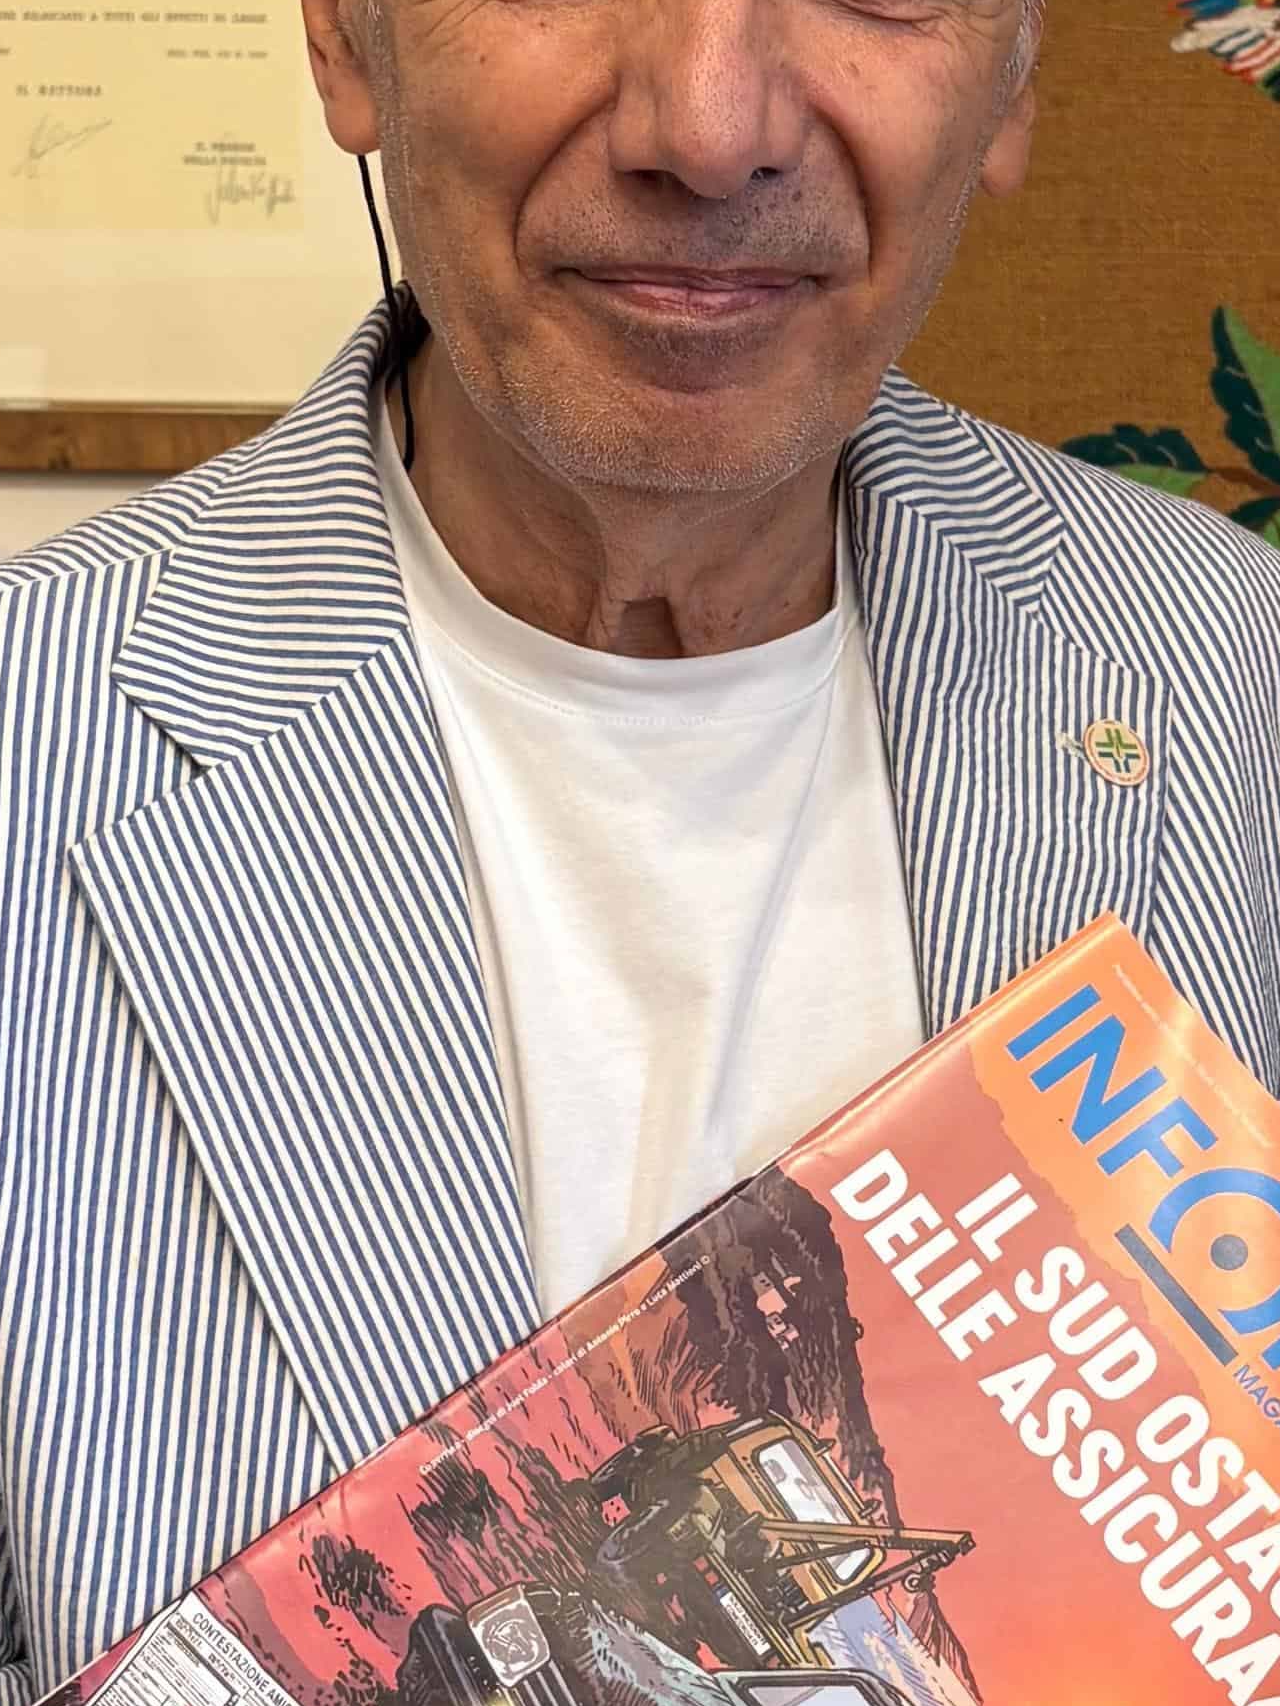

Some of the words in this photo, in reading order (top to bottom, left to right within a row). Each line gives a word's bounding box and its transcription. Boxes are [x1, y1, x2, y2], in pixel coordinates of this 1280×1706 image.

[830, 1149, 1018, 1362] DELLE
[955, 1173, 1038, 1262] IL
[1014, 1246, 1157, 1400] SUD
[193, 1612, 270, 1693] CONTESTAZIONE
